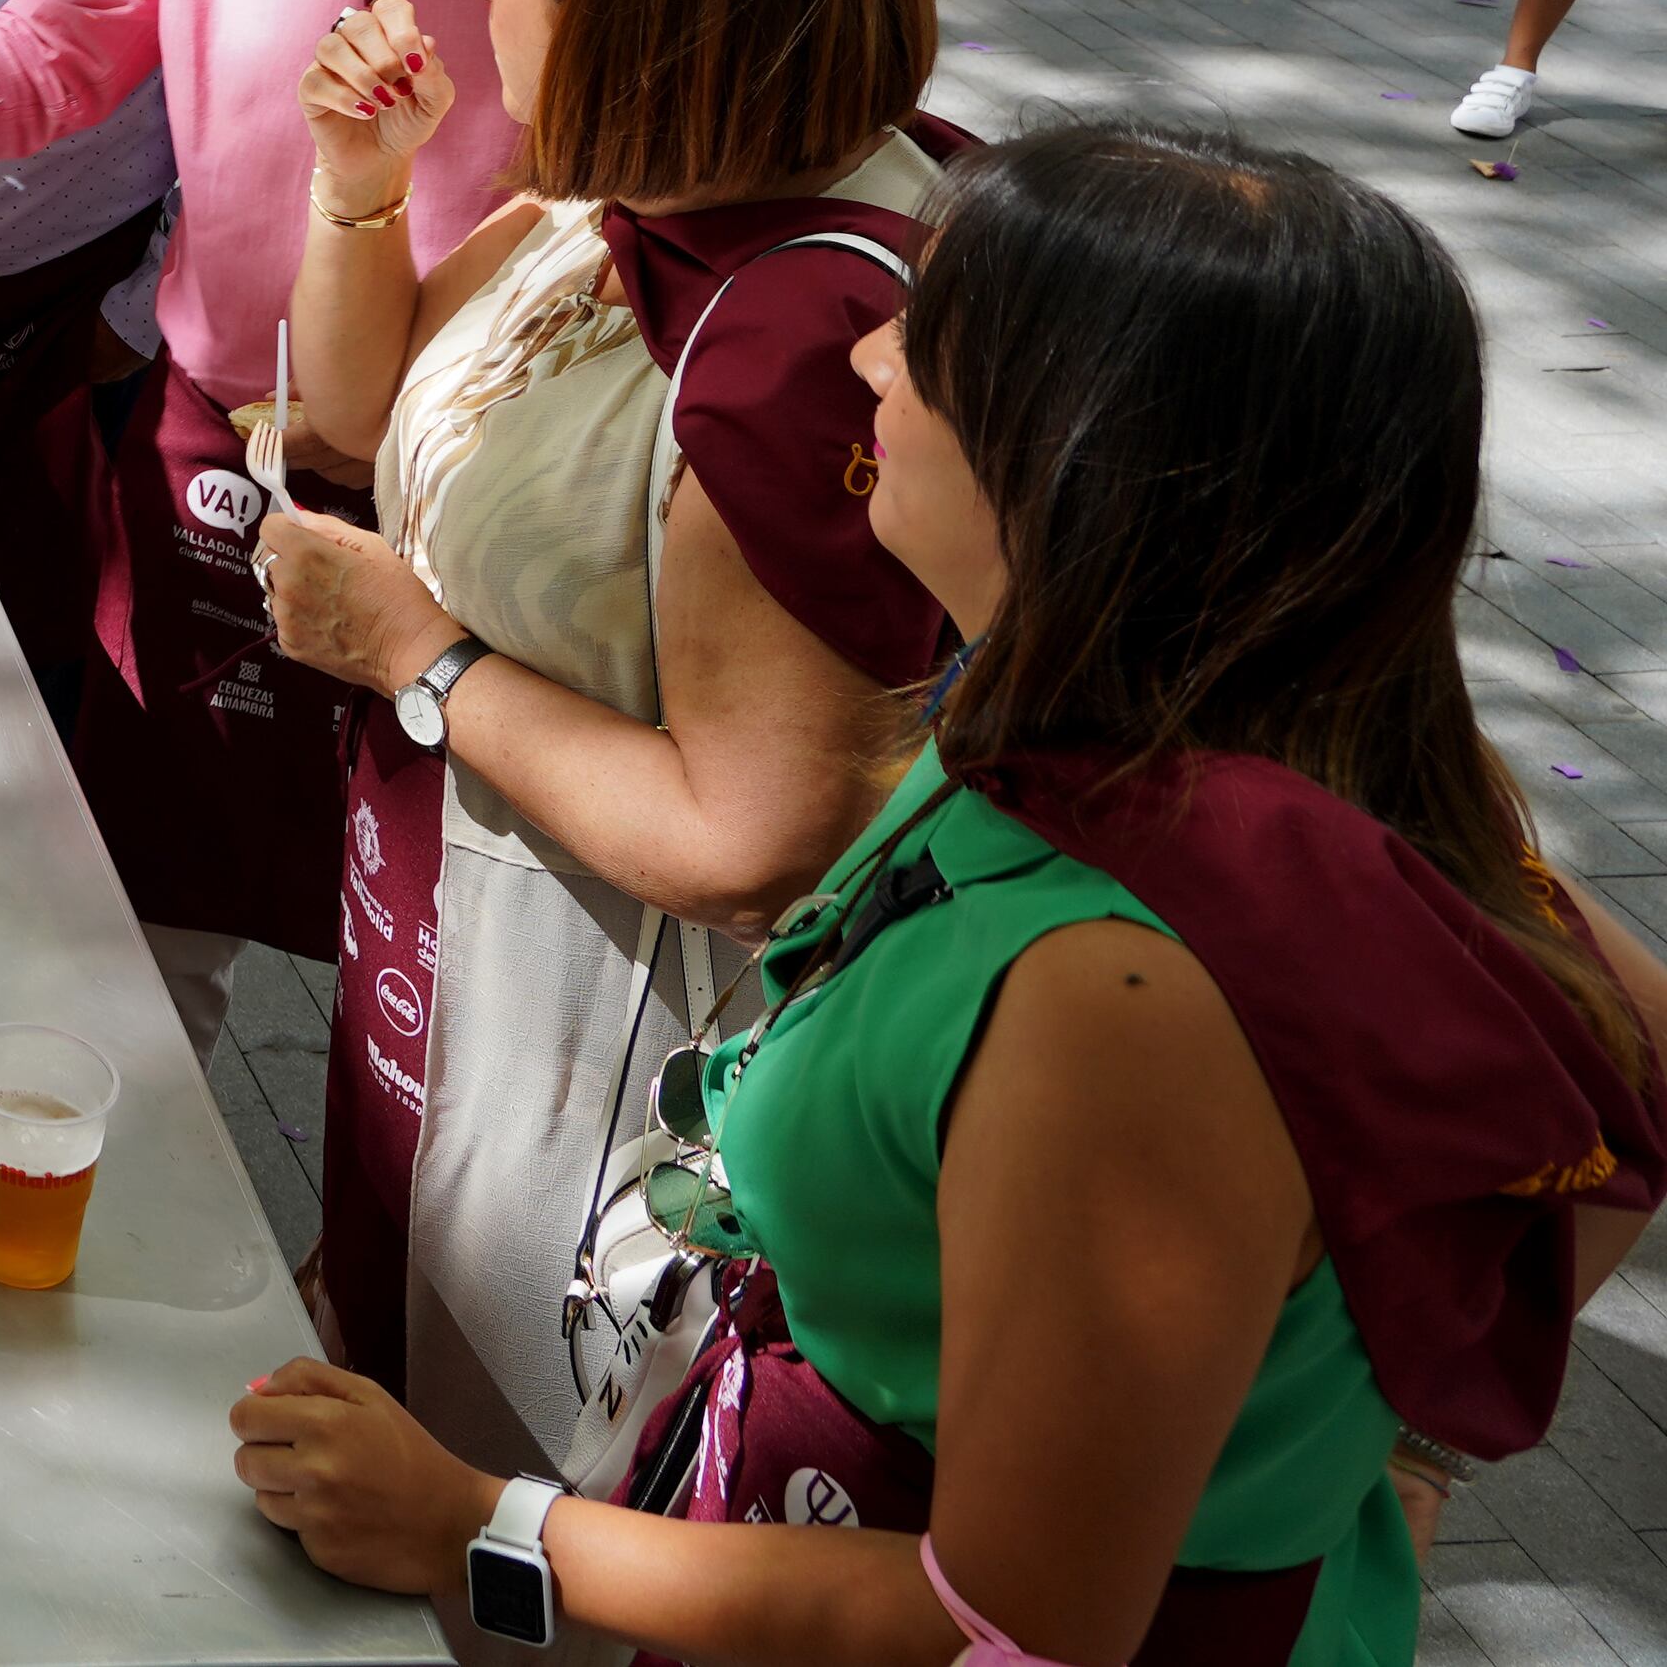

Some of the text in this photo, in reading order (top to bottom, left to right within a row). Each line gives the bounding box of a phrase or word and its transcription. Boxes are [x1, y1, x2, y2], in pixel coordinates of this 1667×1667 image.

[199, 479, 249, 523] VA!
[179, 545, 248, 576] ciudad amiga
[210, 694, 275, 720] ALHAMBRA
[217, 679, 275, 705] CERVEZAS
[380, 984, 418, 1026] Coca-Cola
